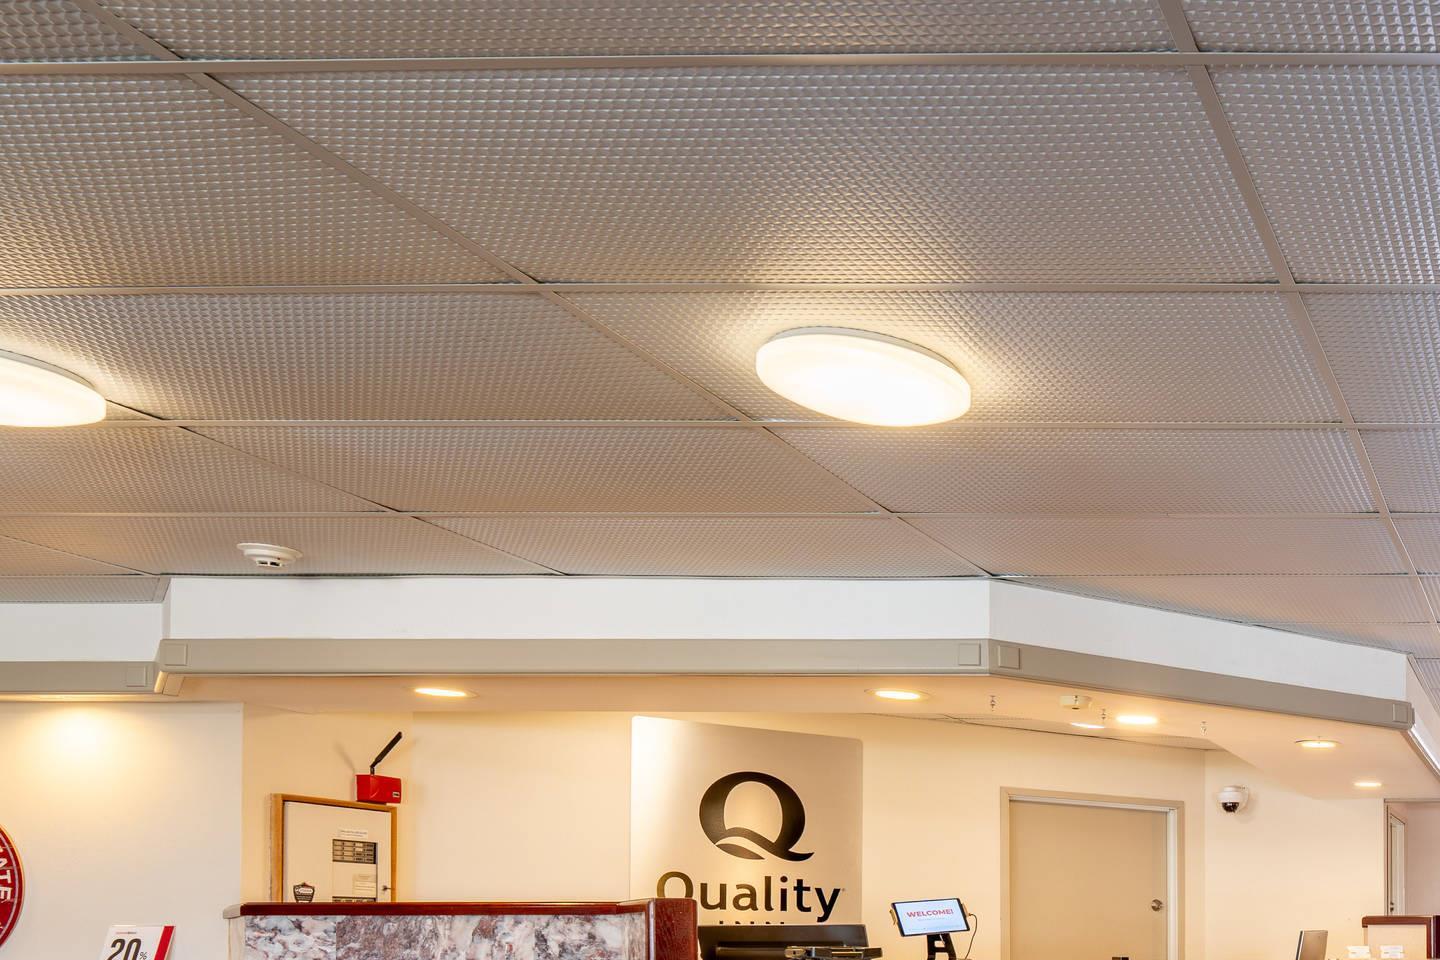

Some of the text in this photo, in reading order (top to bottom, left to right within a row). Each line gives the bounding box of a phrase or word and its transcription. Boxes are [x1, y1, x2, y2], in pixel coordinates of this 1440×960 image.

[699, 771, 815, 862] Q
[656, 871, 842, 923] Quality
[906, 908, 954, 918] WELCOME!
